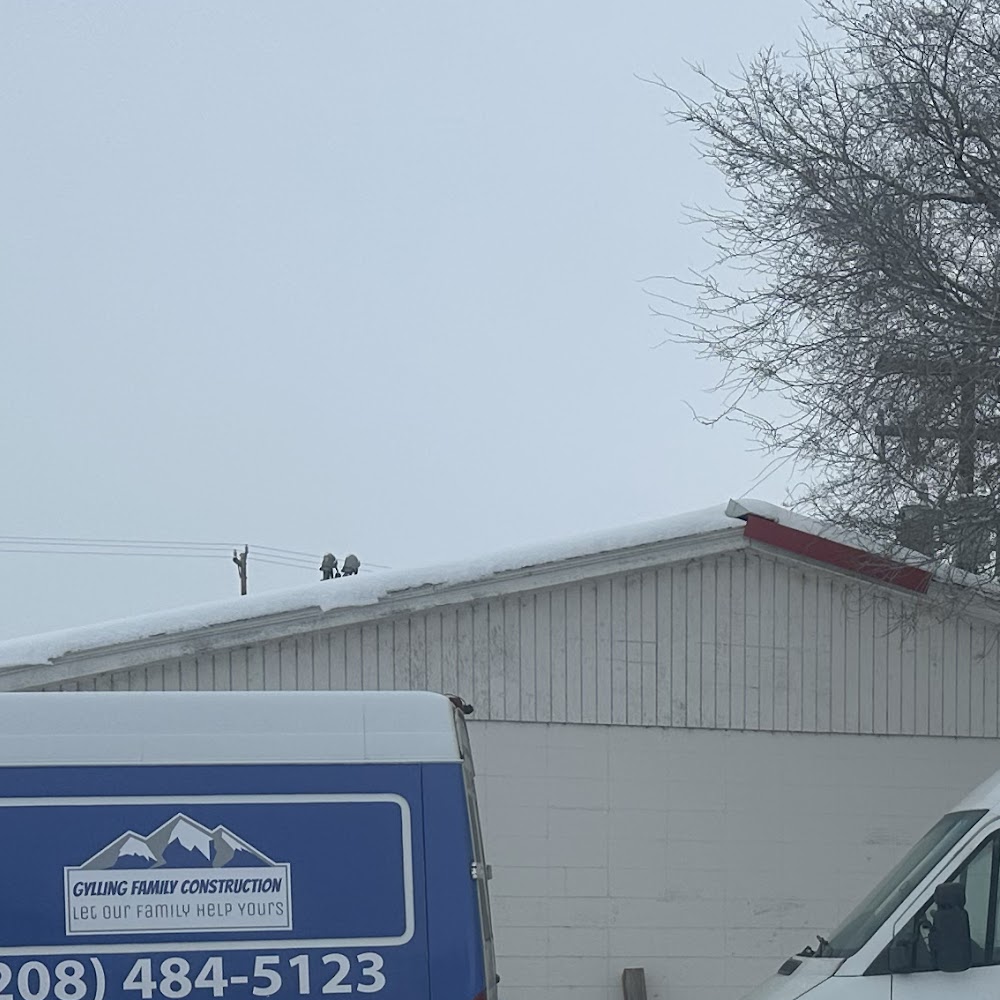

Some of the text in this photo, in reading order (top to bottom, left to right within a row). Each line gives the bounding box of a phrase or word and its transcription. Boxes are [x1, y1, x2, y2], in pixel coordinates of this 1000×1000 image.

[72, 877, 283, 897] GYLLING FAMILY CONSTRUCTION
[122, 952, 387, 999] 484-5123
